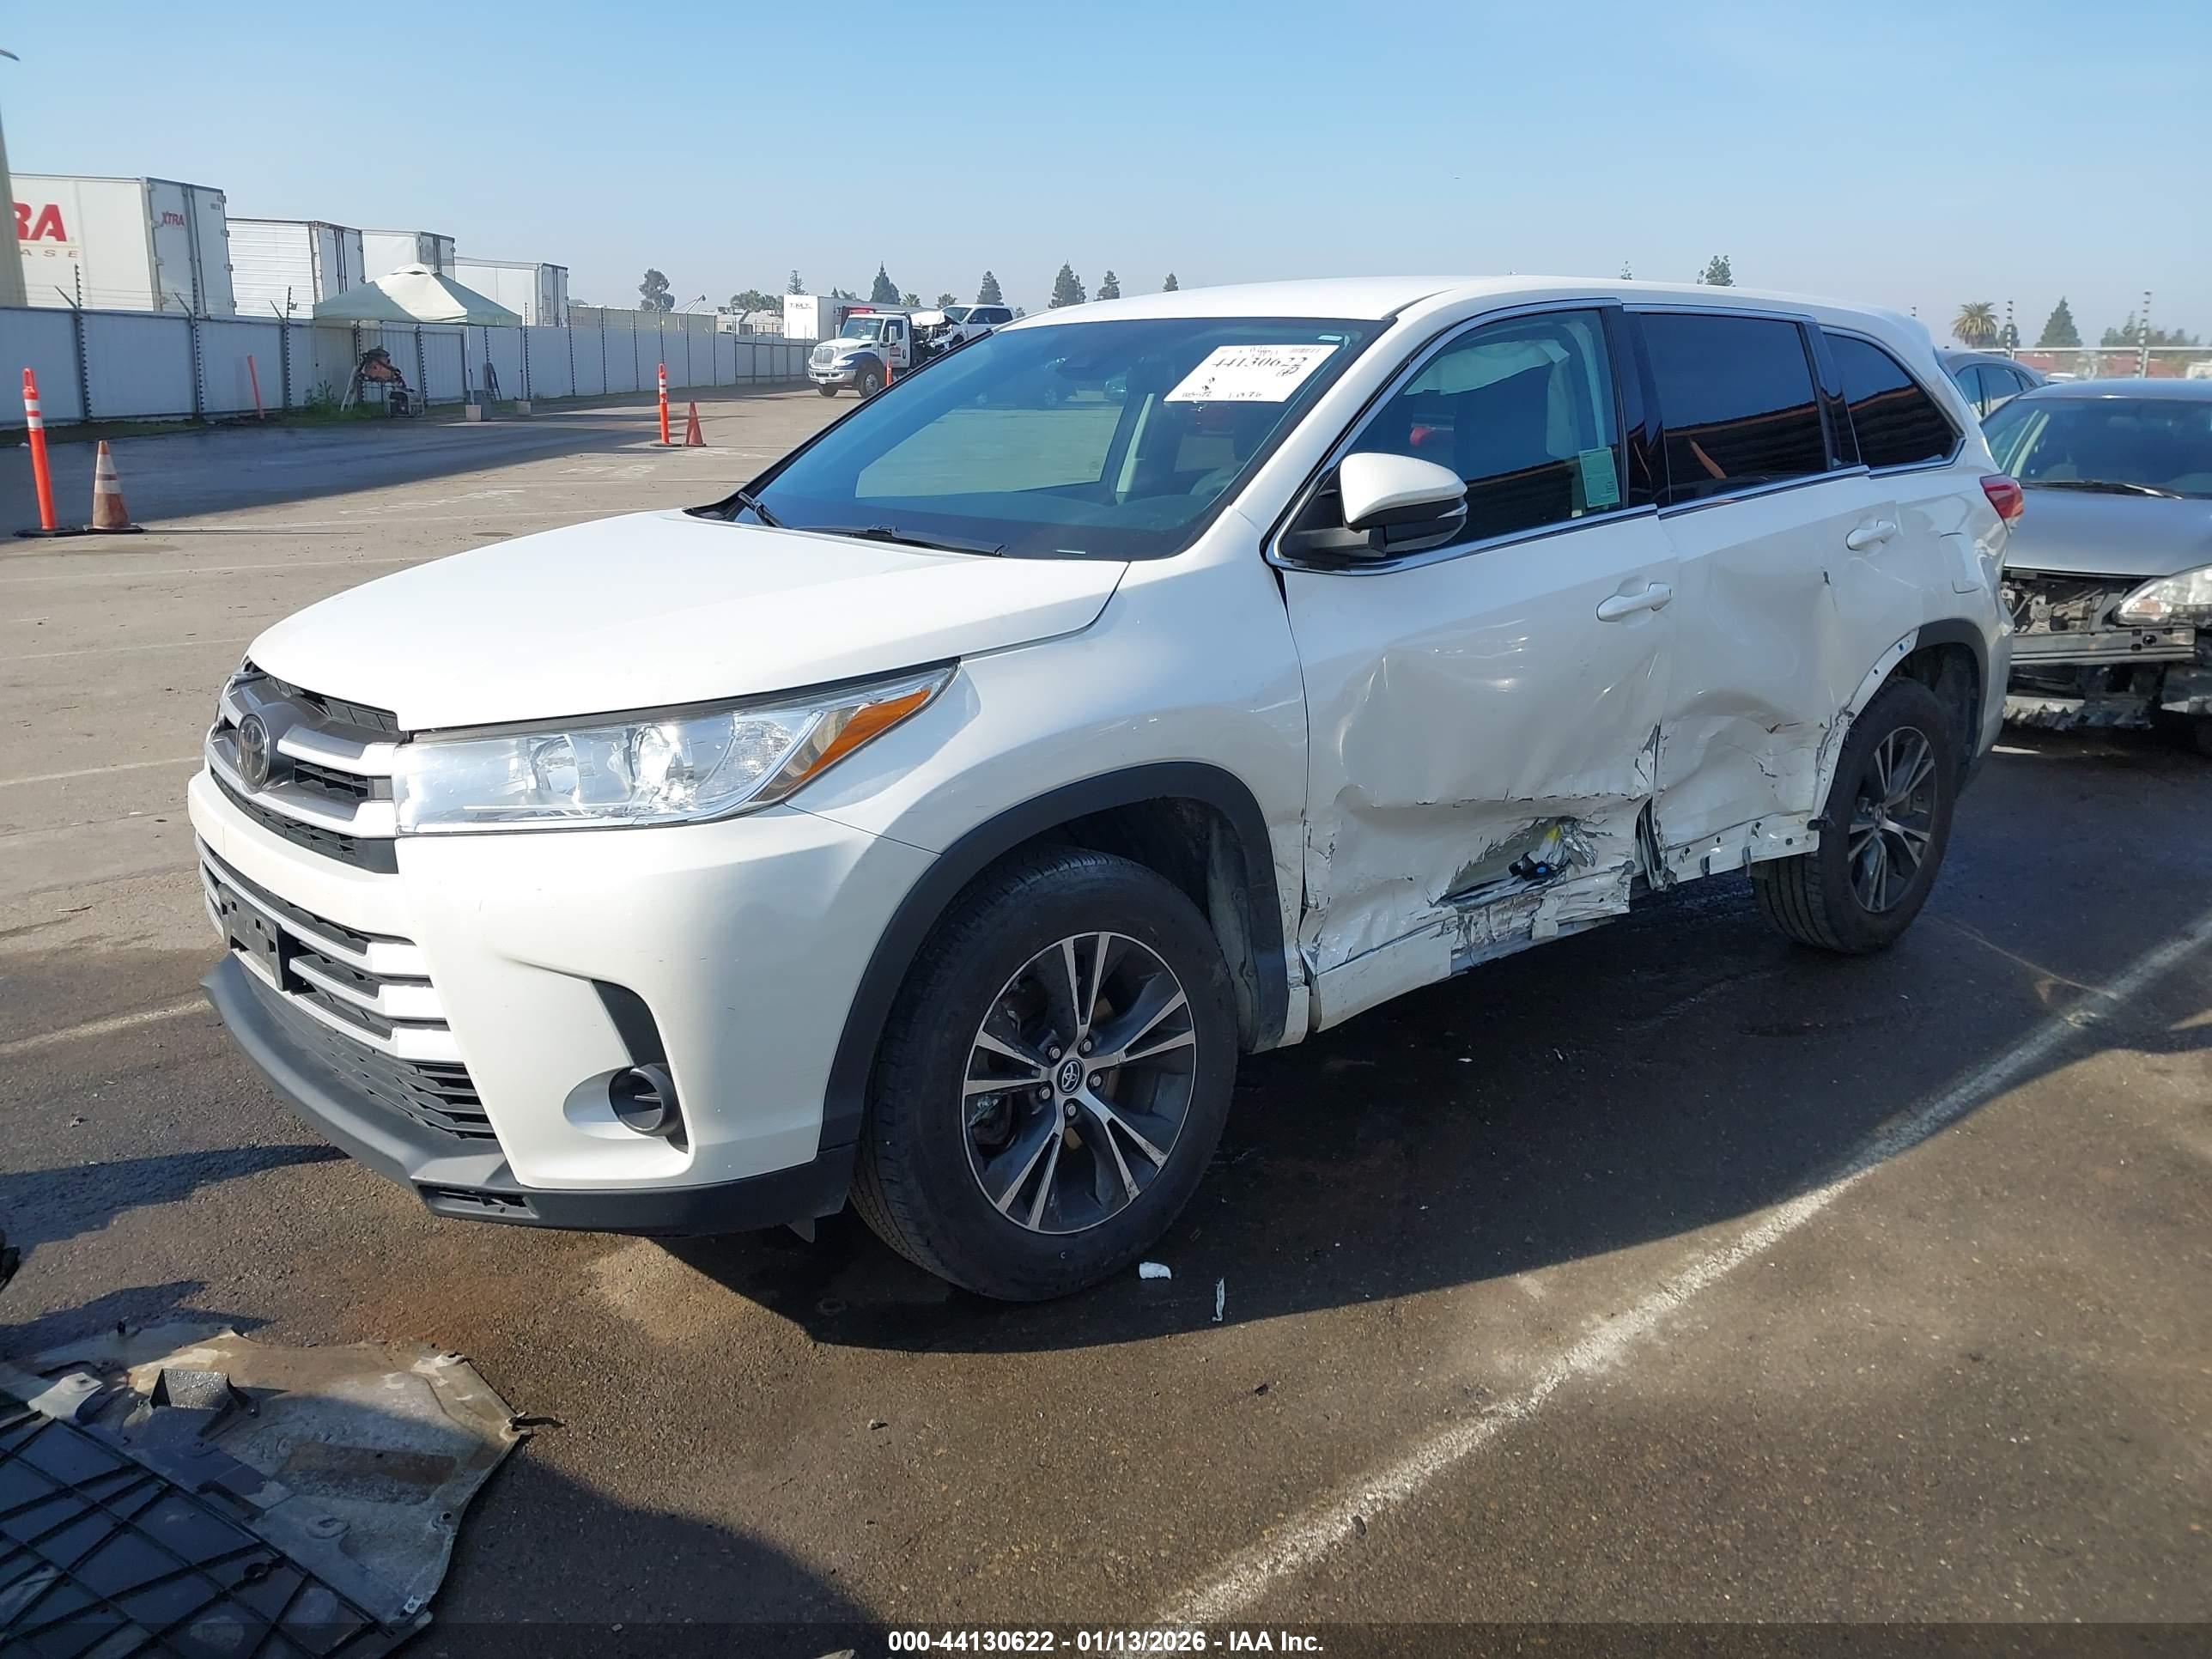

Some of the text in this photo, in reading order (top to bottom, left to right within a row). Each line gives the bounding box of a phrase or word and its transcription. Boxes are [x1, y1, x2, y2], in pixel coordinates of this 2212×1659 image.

[13, 202, 67, 242] RA
[161, 211, 185, 226] XTRA
[21, 249, 79, 258] ASE
